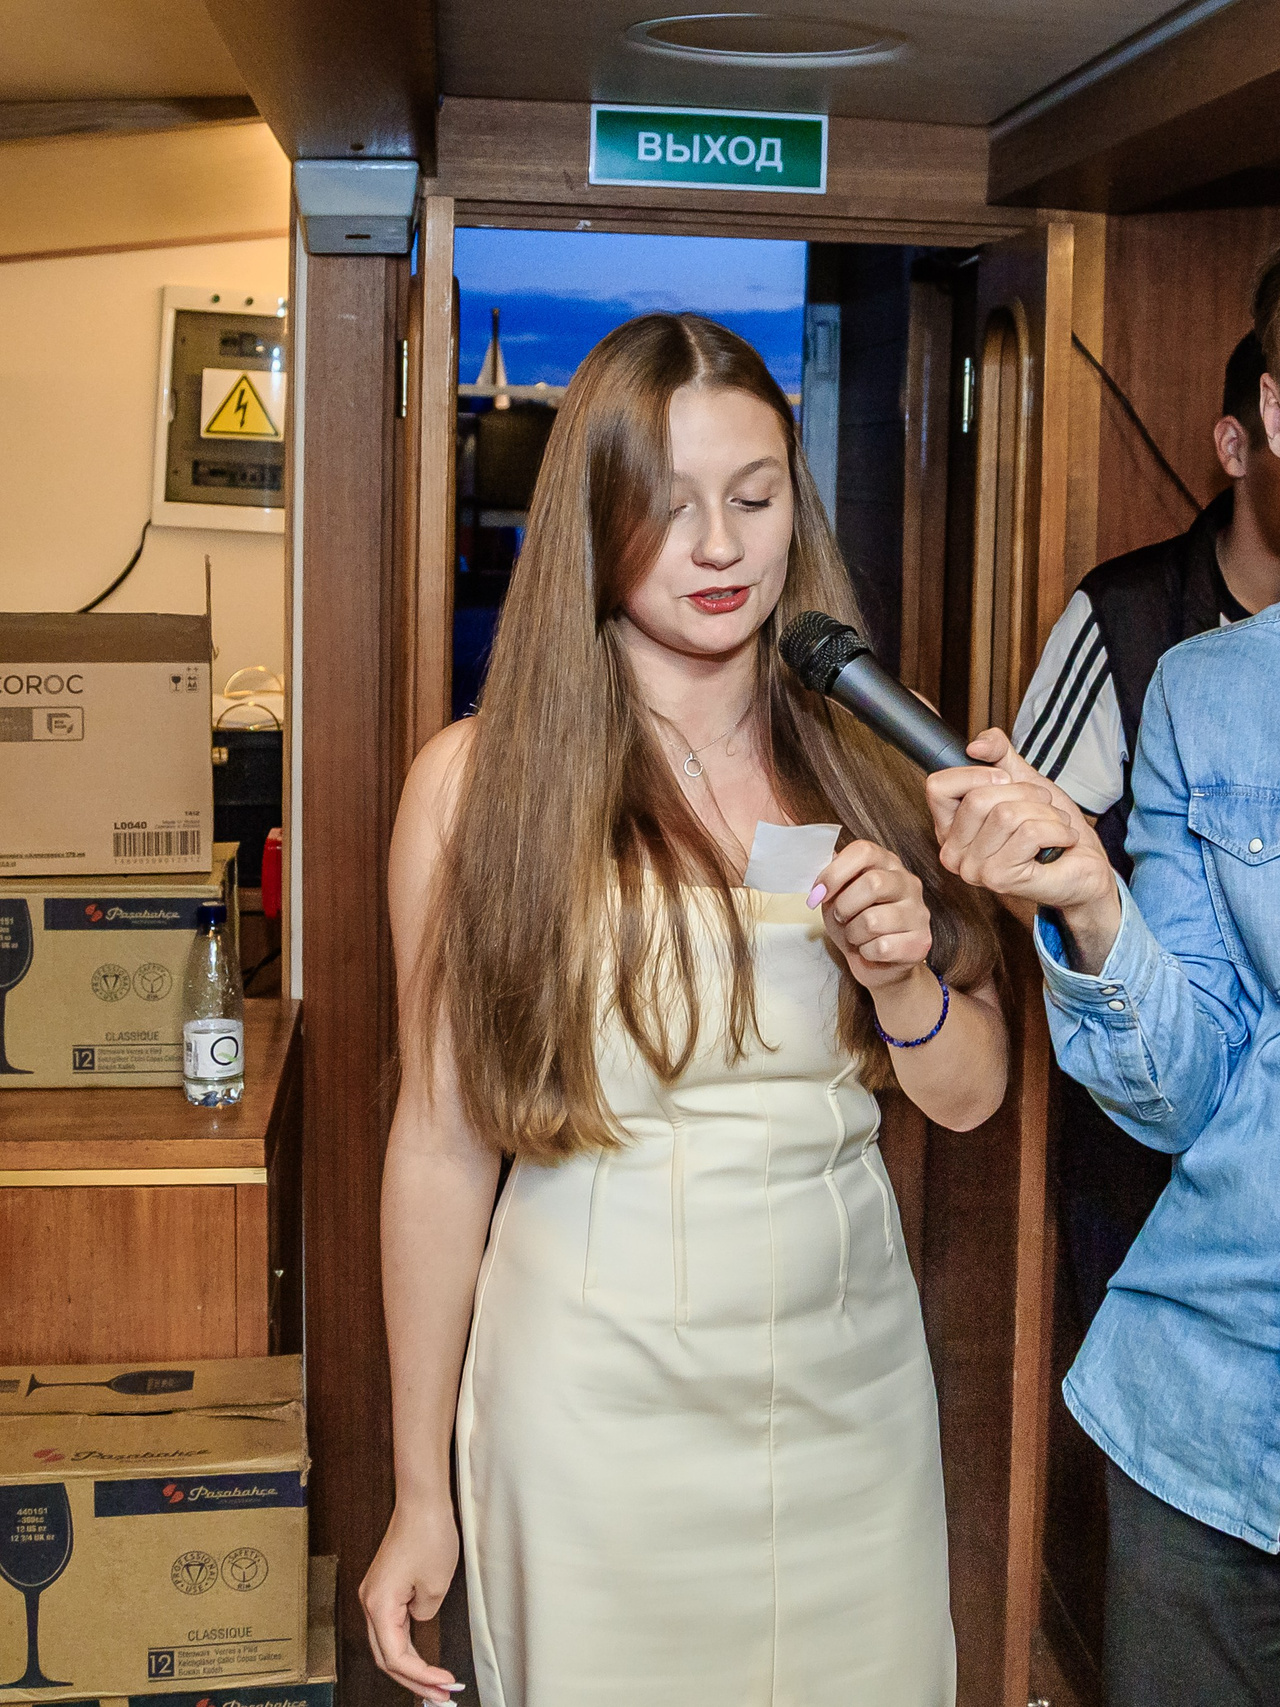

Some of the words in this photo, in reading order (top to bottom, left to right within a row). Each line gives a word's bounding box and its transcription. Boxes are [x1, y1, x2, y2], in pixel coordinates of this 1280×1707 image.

[637, 131, 783, 173] ВЫХОД
[0, 674, 84, 695] OROC
[105, 1031, 159, 1041] CLASSIQUE
[74, 1051, 93, 1068] 12
[172, 1552, 216, 1585] PROFESSIONAL
[185, 1584, 205, 1594] USE
[187, 1627, 253, 1641] CLASSIQUE
[149, 1655, 172, 1674] 12
